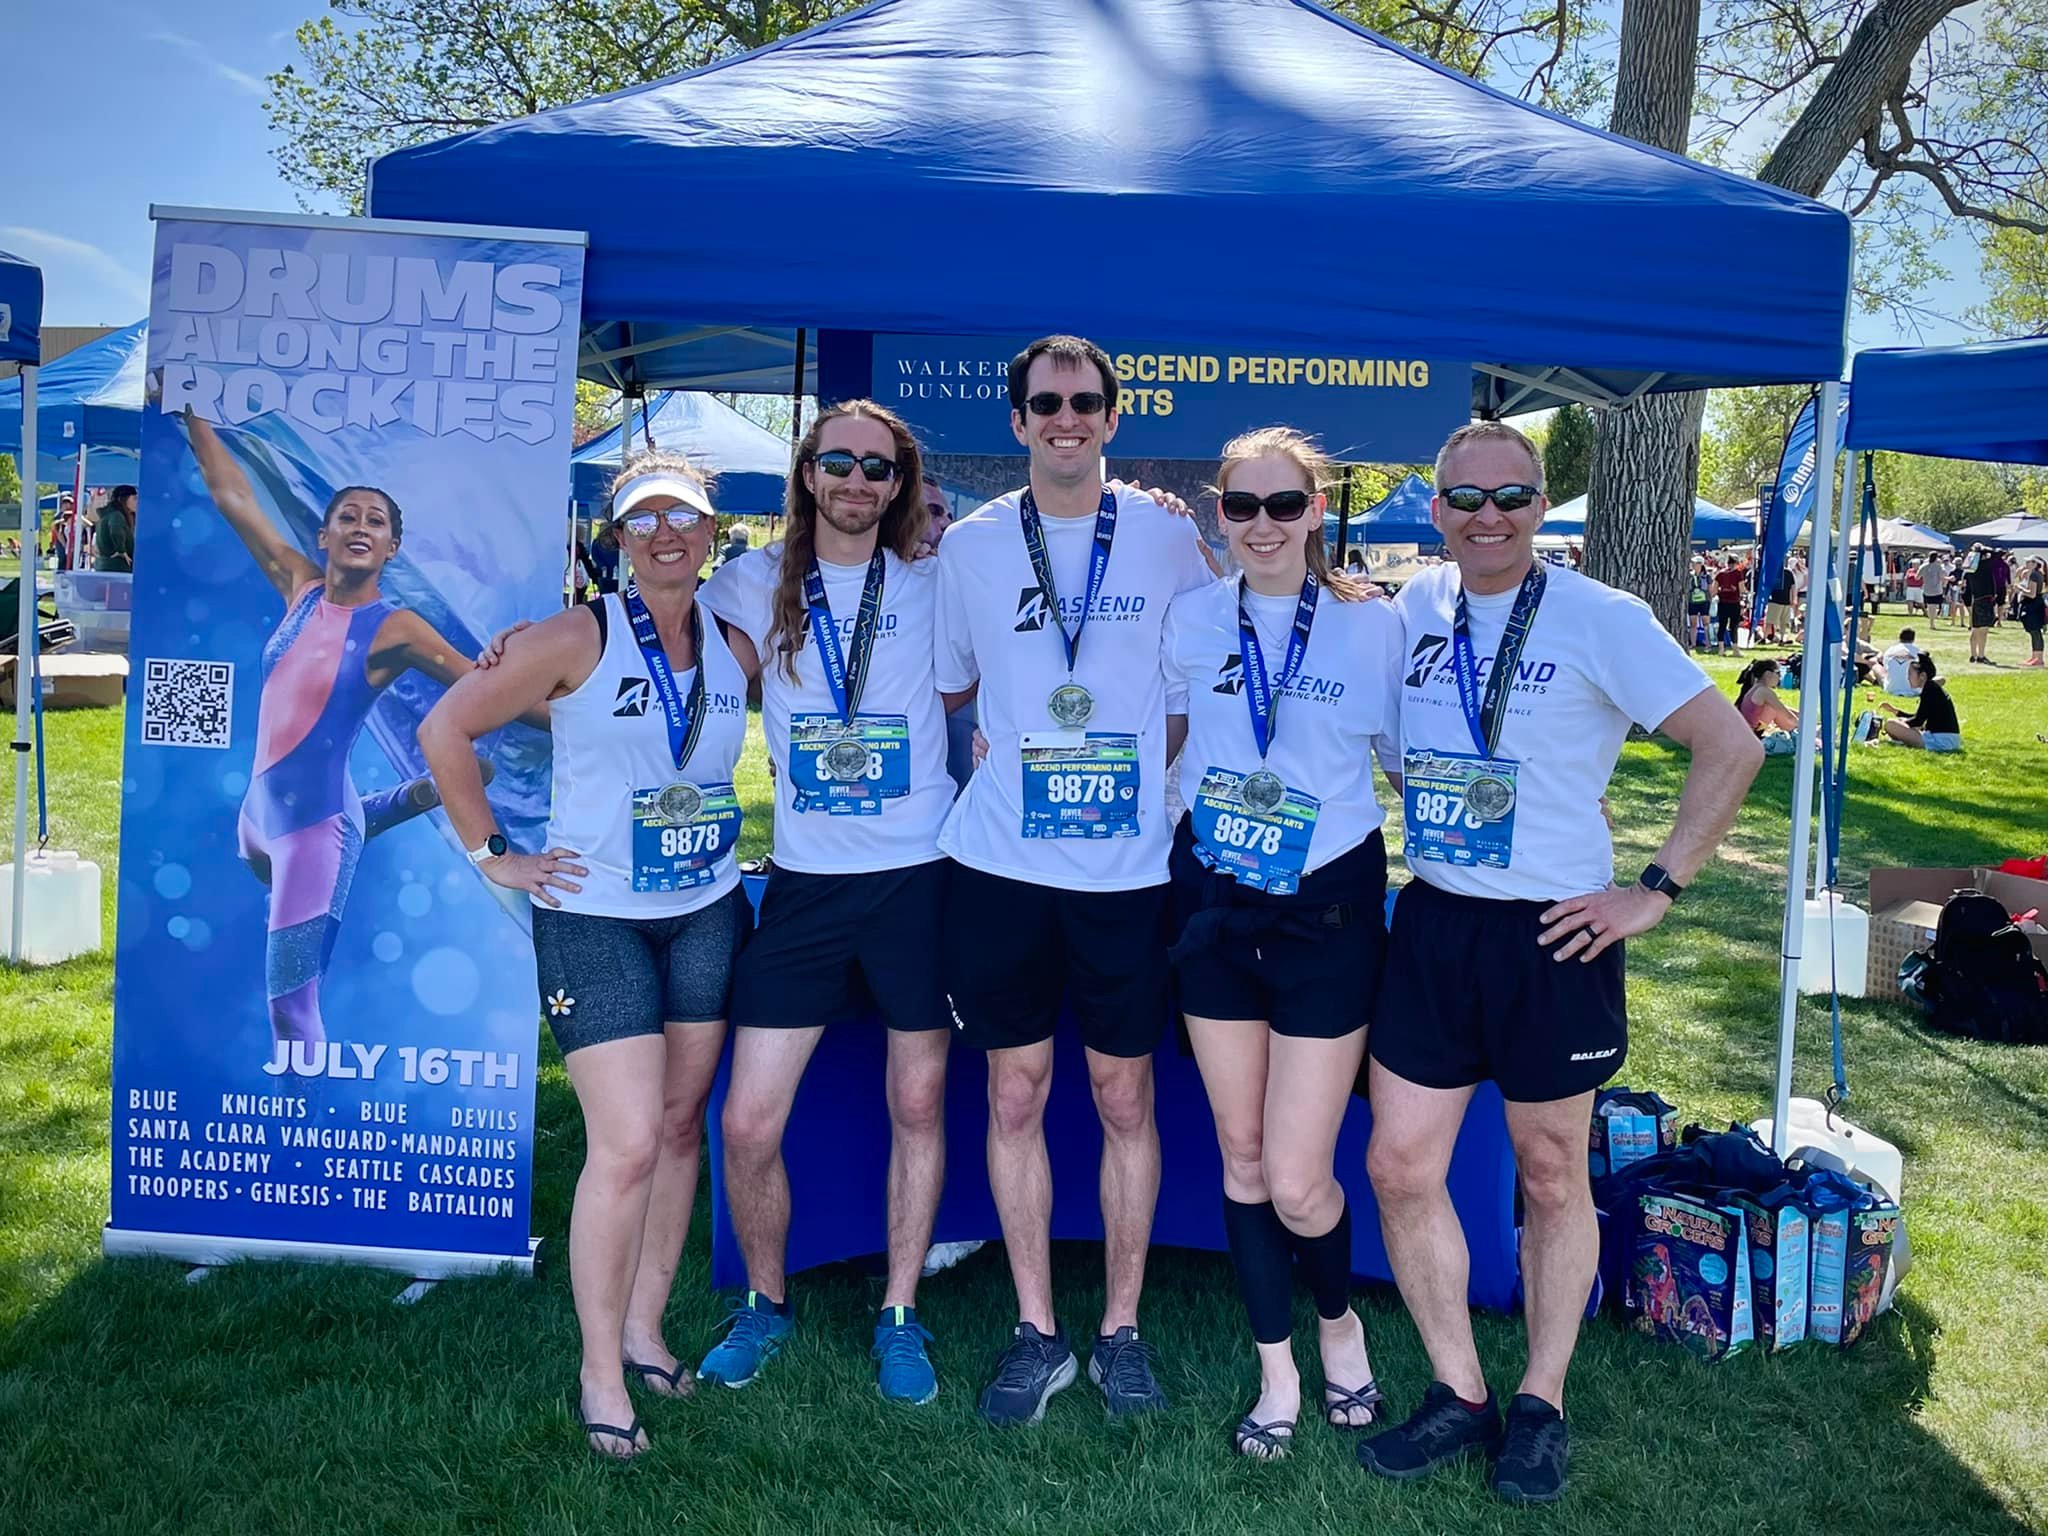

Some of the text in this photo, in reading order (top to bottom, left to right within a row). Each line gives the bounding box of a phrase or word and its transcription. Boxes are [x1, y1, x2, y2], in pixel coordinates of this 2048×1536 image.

[168, 243, 563, 333] DRUMS
[167, 317, 558, 382] ALONG THE
[898, 359, 1008, 376] WALKER
[1108, 354, 1429, 388] SCEND PERFORMING
[161, 364, 555, 445] ROCKIES
[899, 382, 1008, 400] DUNLOP
[1116, 388, 1174, 416] RTS
[1058, 596, 1146, 613] ASEND
[1115, 614, 1141, 622] ARTS
[817, 615, 845, 689] MARATHON RELAY
[1246, 641, 1263, 690] MARATHON
[1439, 655, 1556, 683] ACND
[652, 655, 682, 728] MARATHON RELAY
[1270, 672, 1345, 698] SCEND
[1271, 688, 1340, 706] ORMING ARTS
[1511, 683, 1547, 695] ARTS
[718, 705, 740, 717] ARTS
[1254, 690, 1266, 716] RELAY
[815, 752, 883, 781] 98
[1030, 763, 1131, 772] ASCEND PERFORMING ARTS
[1047, 774, 1115, 803] 9878
[1430, 782, 1464, 793] PERFOR
[1203, 797, 1232, 811] ASCEND
[1283, 818, 1304, 830] ARTS
[661, 823, 720, 857] 9878
[1213, 813, 1282, 855] 9878
[262, 1040, 519, 1088] JULY 16TH
[1570, 1047, 1618, 1061] BALEAF
[130, 1089, 517, 1131] BLUE KNIGHTS BLUE DEVILS
[128, 1118, 516, 1160] SANTA CLARA VANGUARD MANDARINS
[128, 1146, 515, 1189] THE ACADEMY SEATTLE CASCADES
[128, 1175, 513, 1218] TROOPERS GENESIS THE BATTALION
[1662, 1206, 1727, 1238] NATURAL
